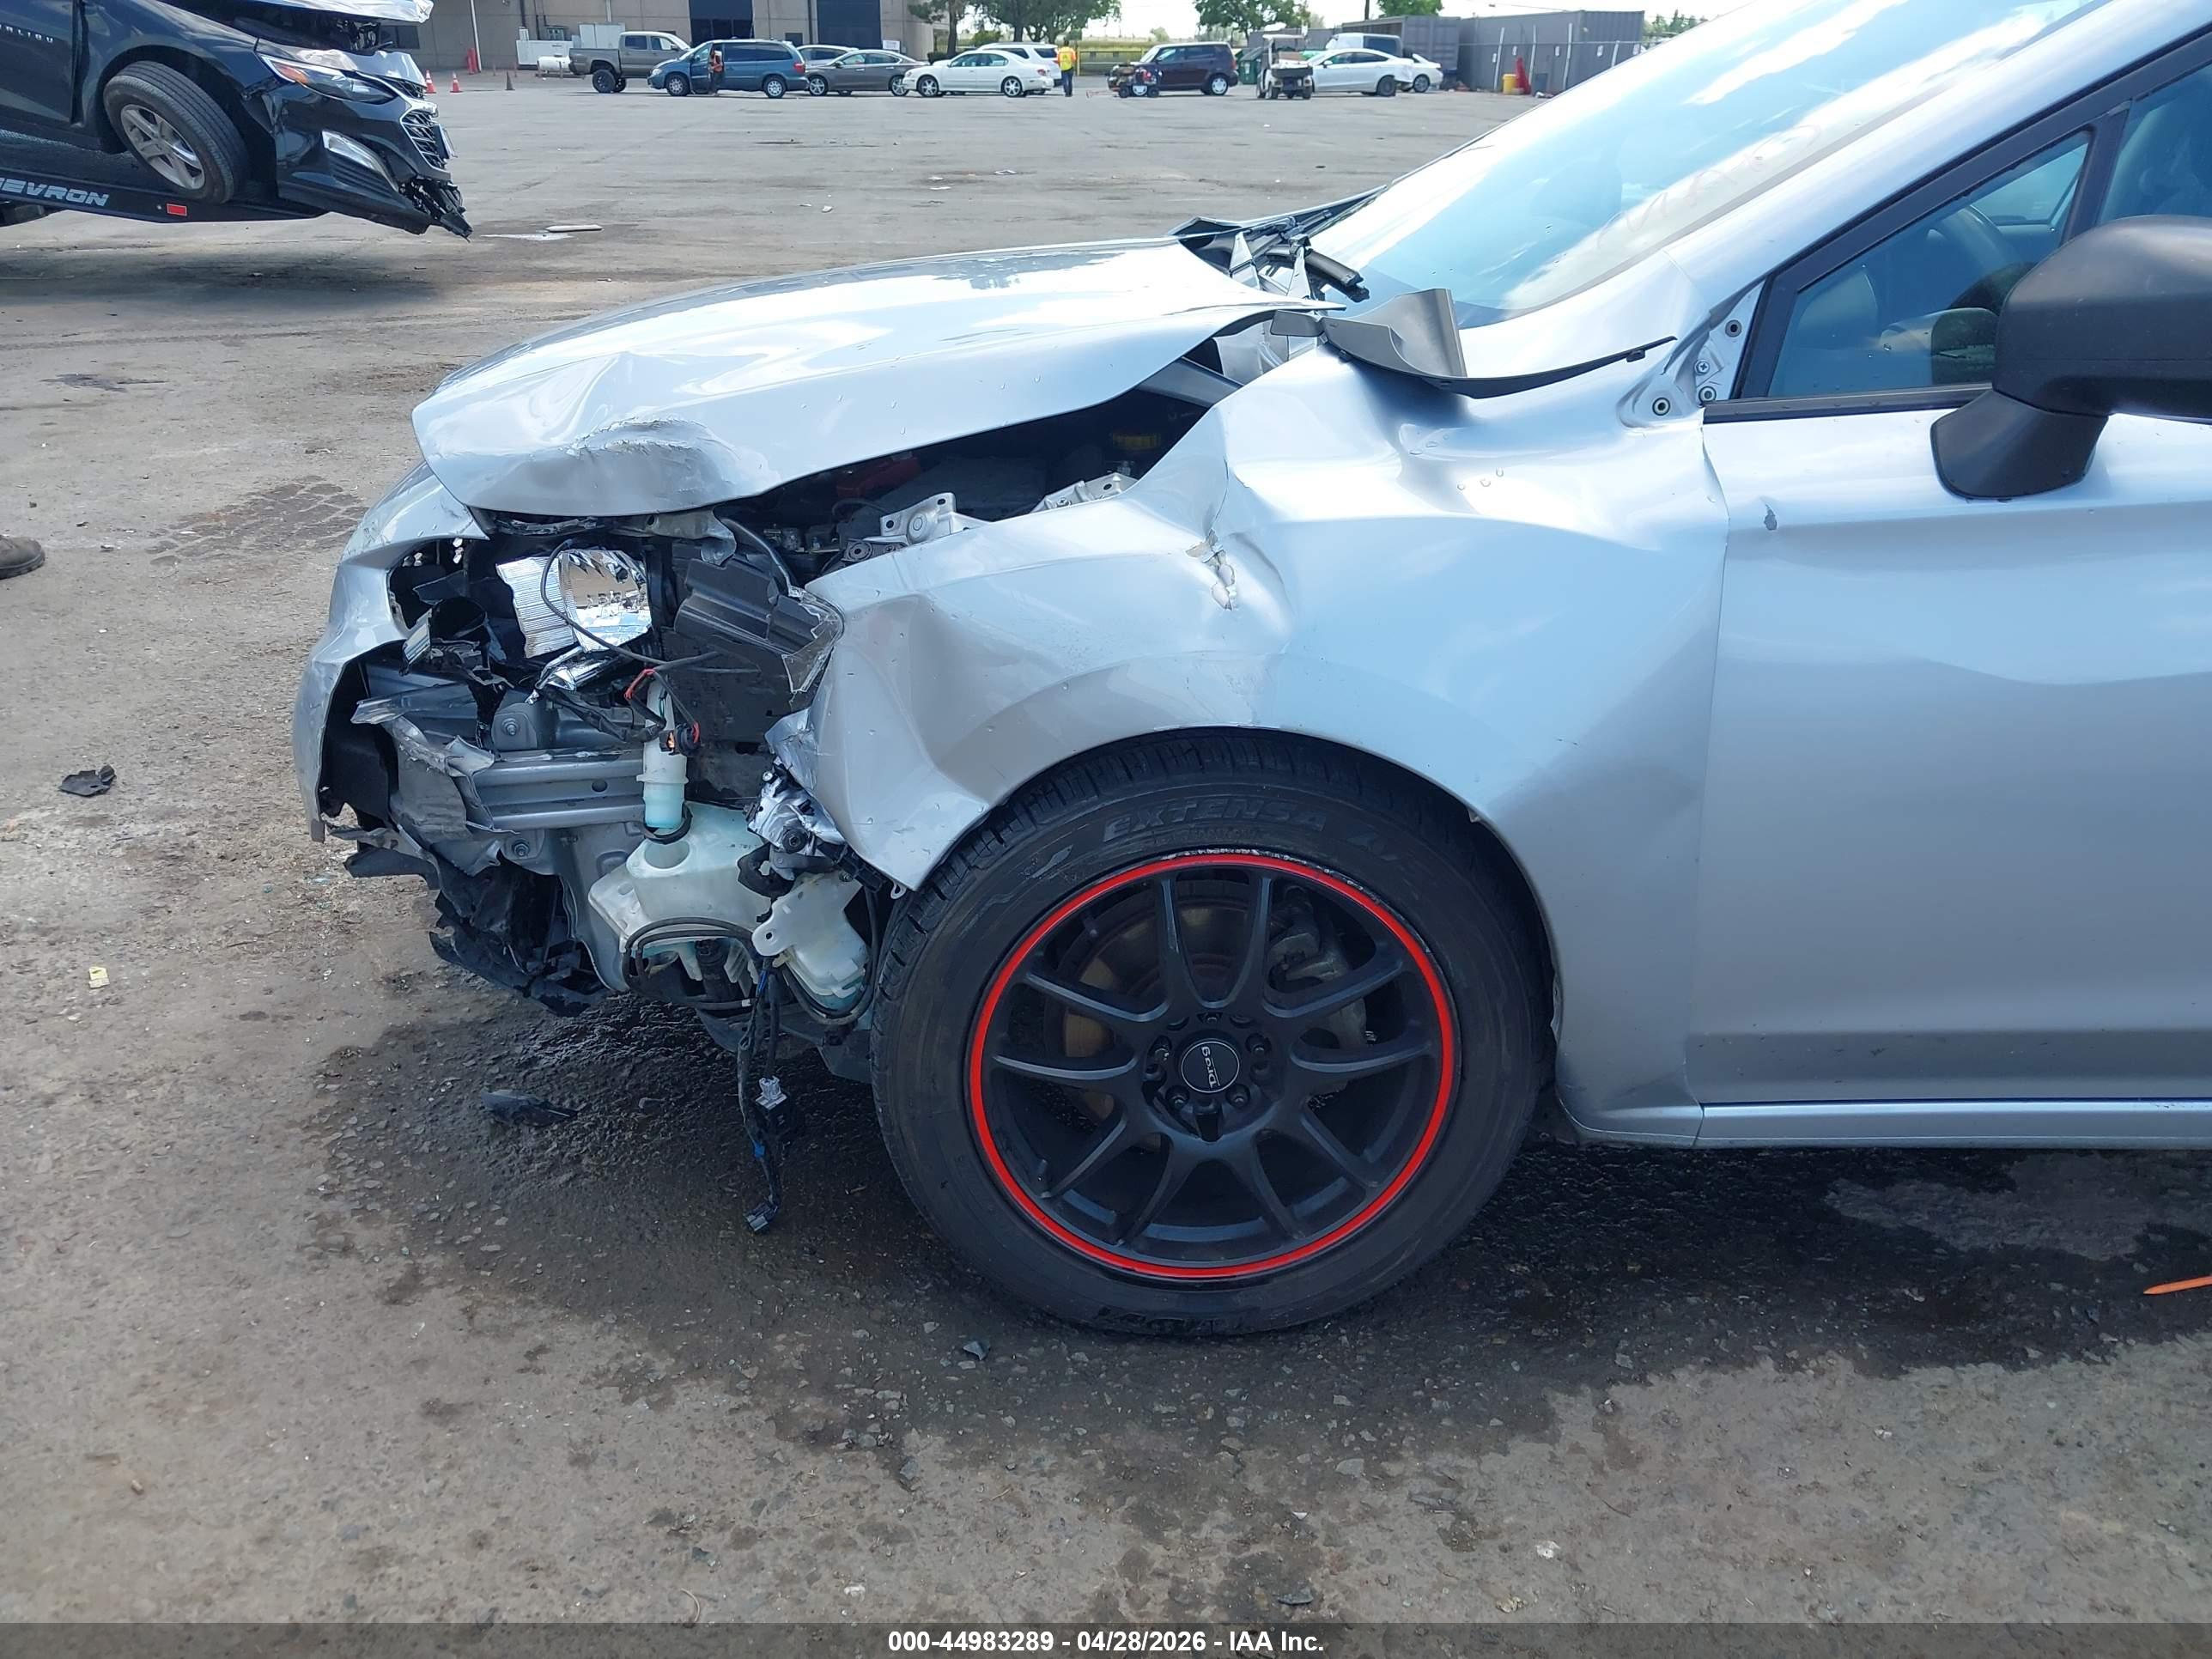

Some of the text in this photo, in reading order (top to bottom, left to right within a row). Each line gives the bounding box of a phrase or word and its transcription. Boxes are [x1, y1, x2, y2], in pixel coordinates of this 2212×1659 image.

[0, 24, 53, 44] ALIBU
[0, 177, 110, 206] EVRON
[1103, 799, 1327, 842] EXTENSA
